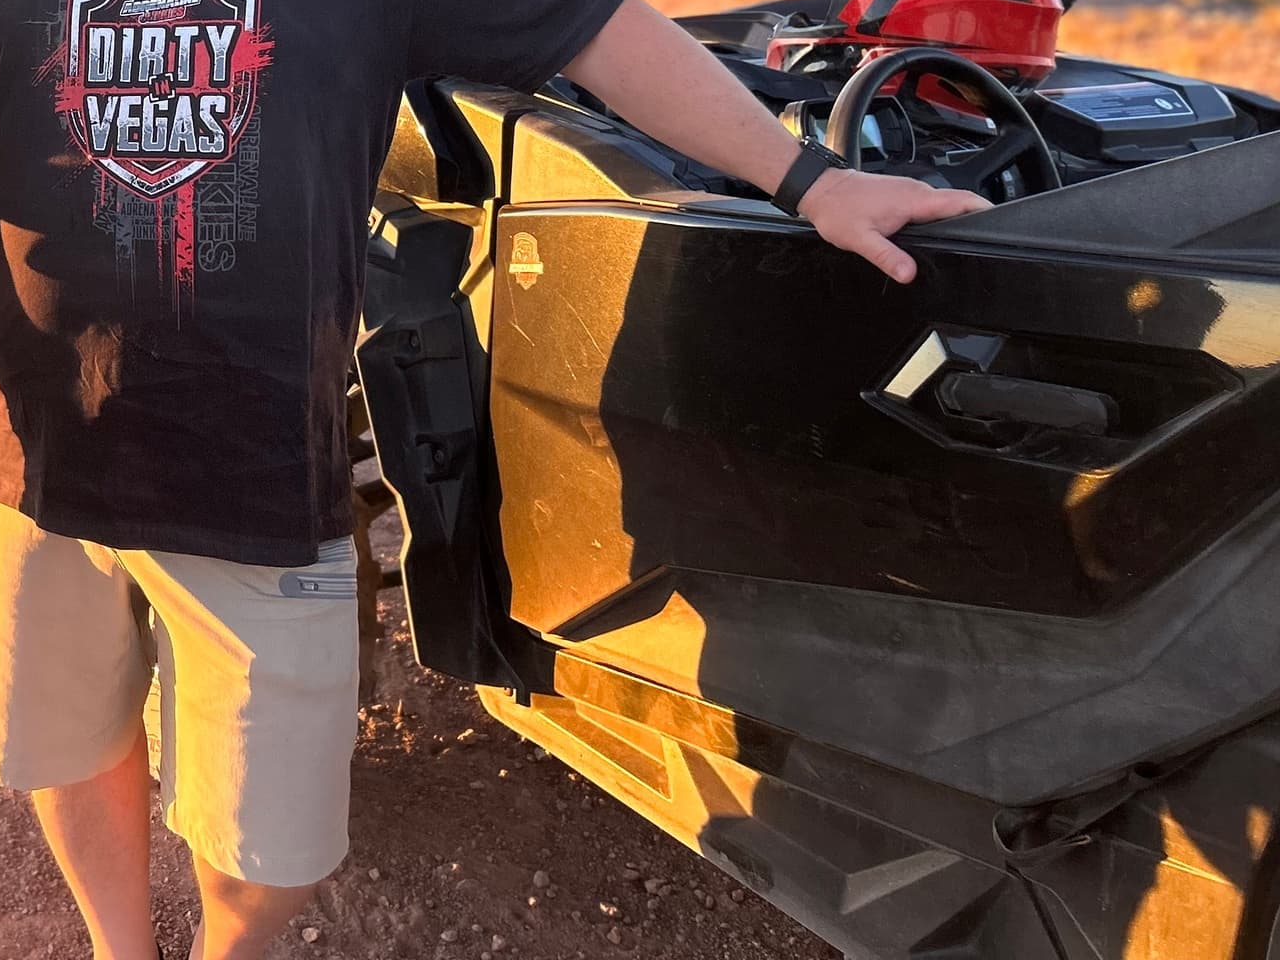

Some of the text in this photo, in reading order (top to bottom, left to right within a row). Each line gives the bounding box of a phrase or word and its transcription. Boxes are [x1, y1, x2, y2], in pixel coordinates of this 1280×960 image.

[86, 24, 237, 83] DIRTY
[153, 80, 171, 96] IN
[86, 93, 226, 154] VEGAS
